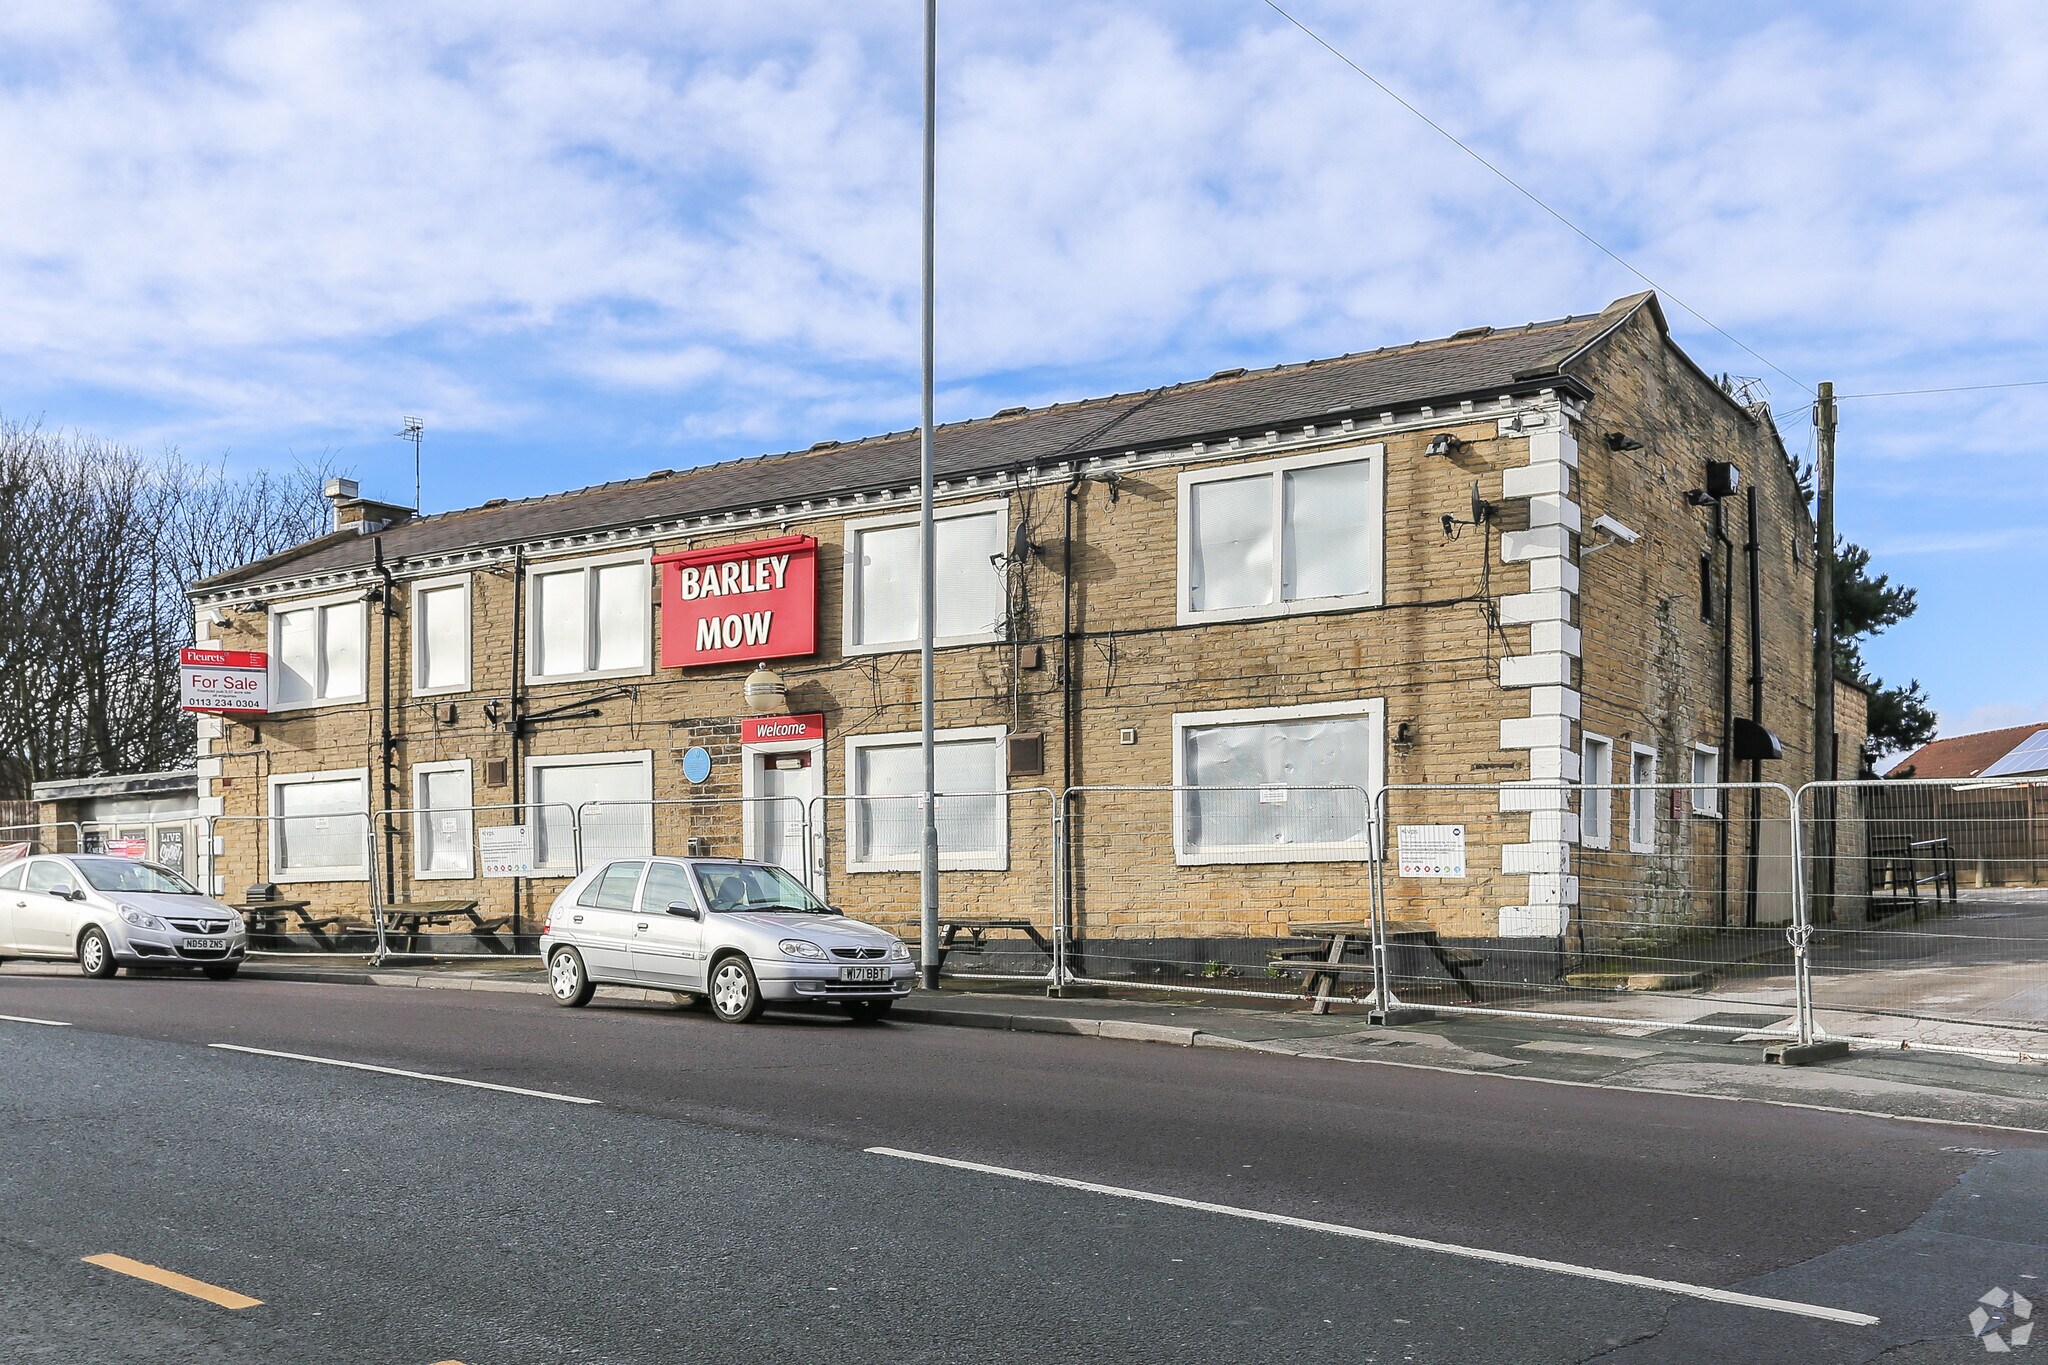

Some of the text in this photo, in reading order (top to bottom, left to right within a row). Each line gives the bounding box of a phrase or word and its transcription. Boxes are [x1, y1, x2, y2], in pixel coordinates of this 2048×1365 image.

[681, 554, 790, 601] BARLEY
[695, 610, 773, 652] MOW
[187, 651, 225, 662] Fleurets
[192, 675, 258, 690] For Sale
[189, 698, 212, 706] 0113
[756, 721, 807, 738] Welcome
[160, 832, 181, 843] LIVE
[187, 940, 223, 948] ND58 ZNS
